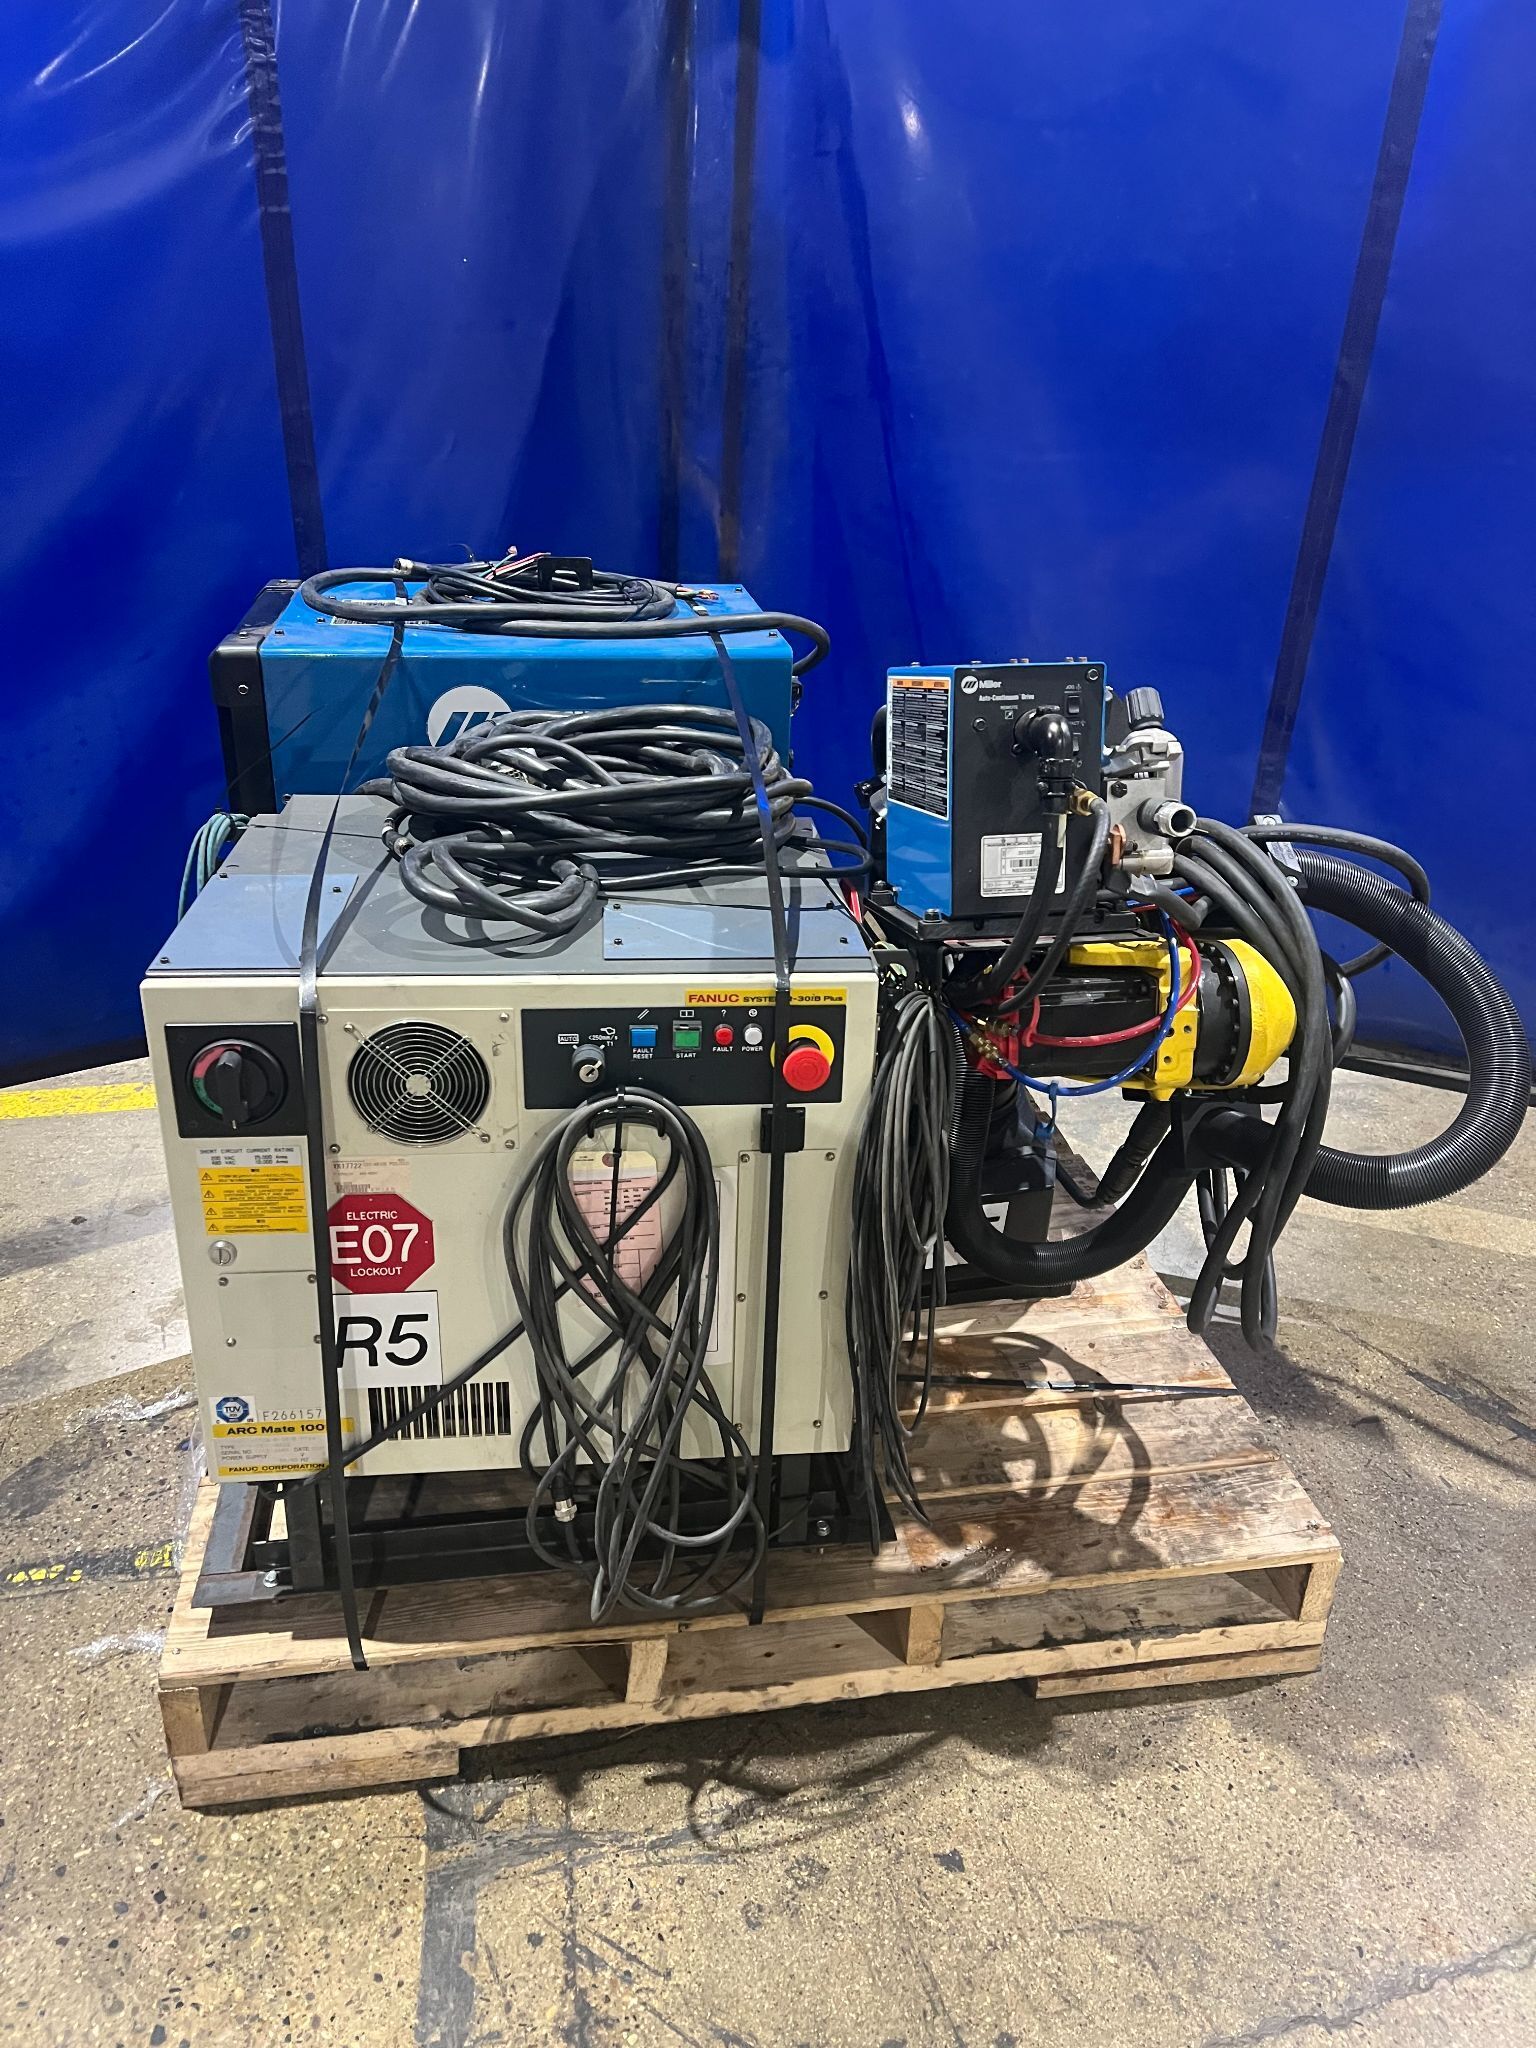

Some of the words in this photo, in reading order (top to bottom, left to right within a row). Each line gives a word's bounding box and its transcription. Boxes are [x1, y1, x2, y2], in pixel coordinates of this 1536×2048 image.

[979, 679, 1002, 689] Miller
[688, 993, 740, 1003] FANUC
[789, 993, 821, 1002] -30iB
[346, 1210, 398, 1221] ELECTRIC
[329, 1223, 419, 1265] E07
[350, 1266, 403, 1277] LOCKOUT
[336, 1313, 429, 1369] R5
[262, 1408, 322, 1421] F266157
[227, 1426, 258, 1435] ARC
[261, 1425, 295, 1434] Mate
[300, 1423, 325, 1432] 100
[228, 1465, 259, 1473] FANUC
[261, 1463, 325, 1472] CORPORATION
